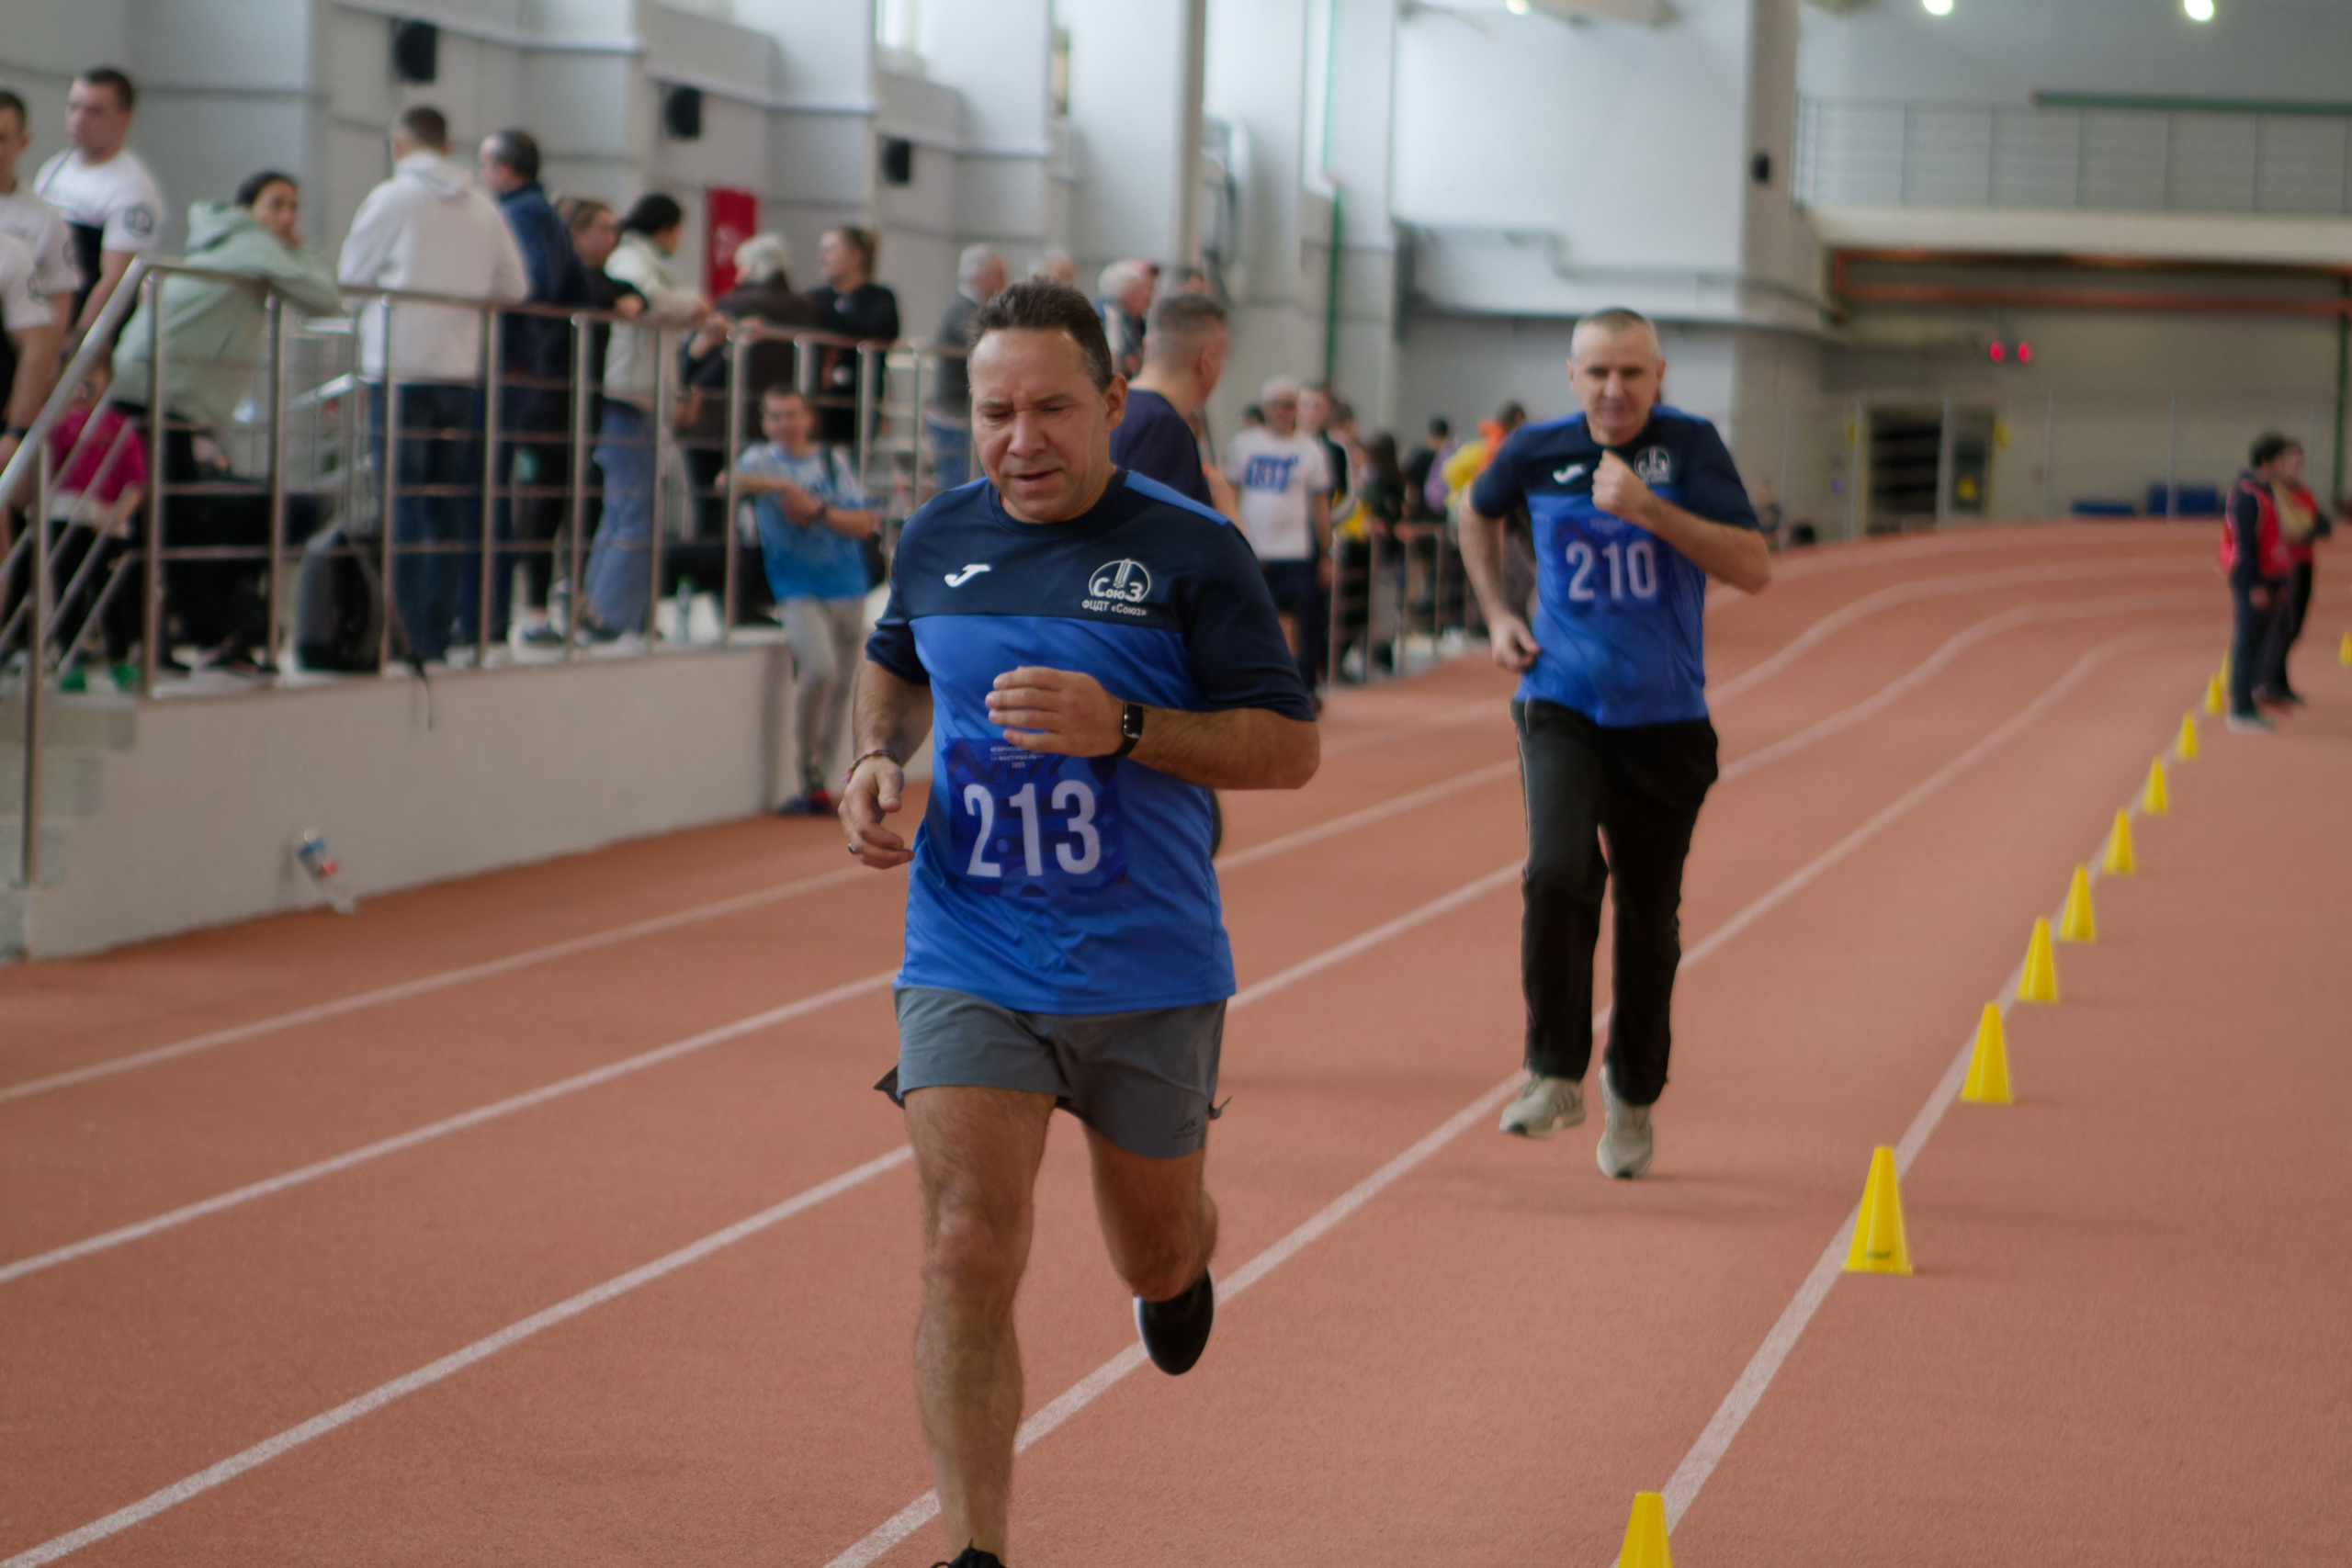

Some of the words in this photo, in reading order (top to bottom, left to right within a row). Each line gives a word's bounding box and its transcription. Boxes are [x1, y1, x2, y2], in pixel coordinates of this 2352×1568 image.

[1565, 540, 1657, 603] 210
[1081, 599, 1110, 613] ФЦДТ
[963, 779, 1102, 878] 213
